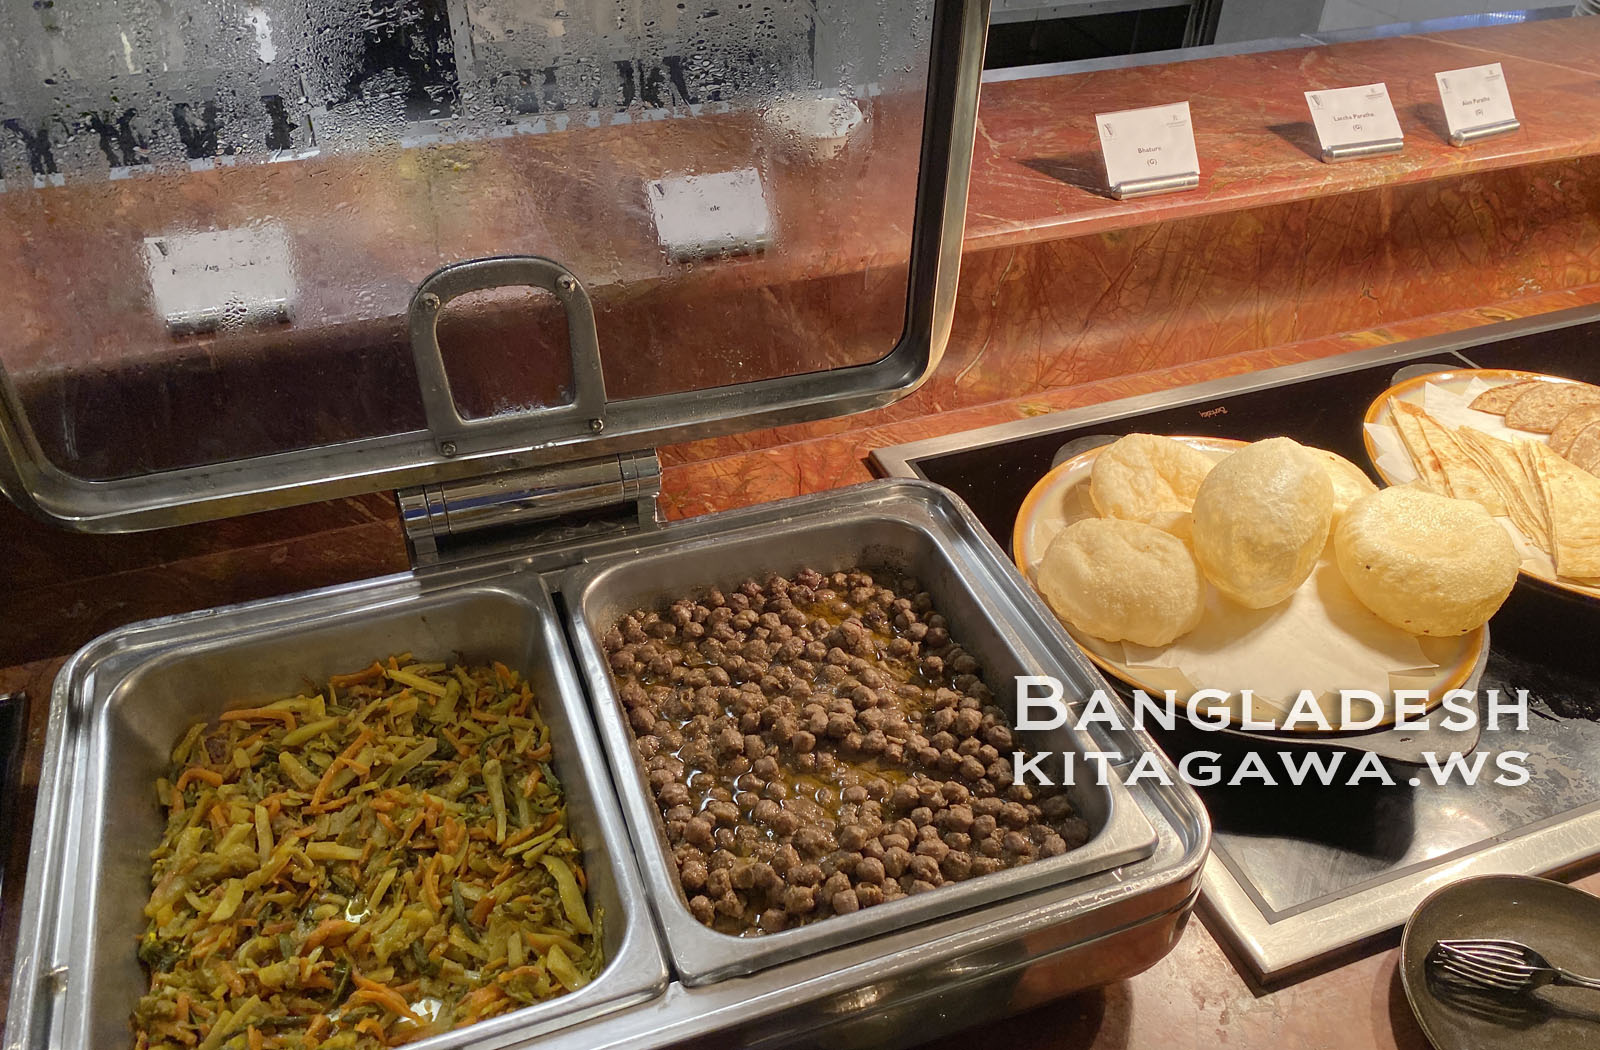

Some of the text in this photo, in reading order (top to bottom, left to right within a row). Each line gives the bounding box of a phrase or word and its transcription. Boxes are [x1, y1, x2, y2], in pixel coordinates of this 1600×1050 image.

[1352, 111, 1374, 119] Paratha
[1352, 124, 1363, 132] (G)
[1146, 158, 1158, 167] (G)
